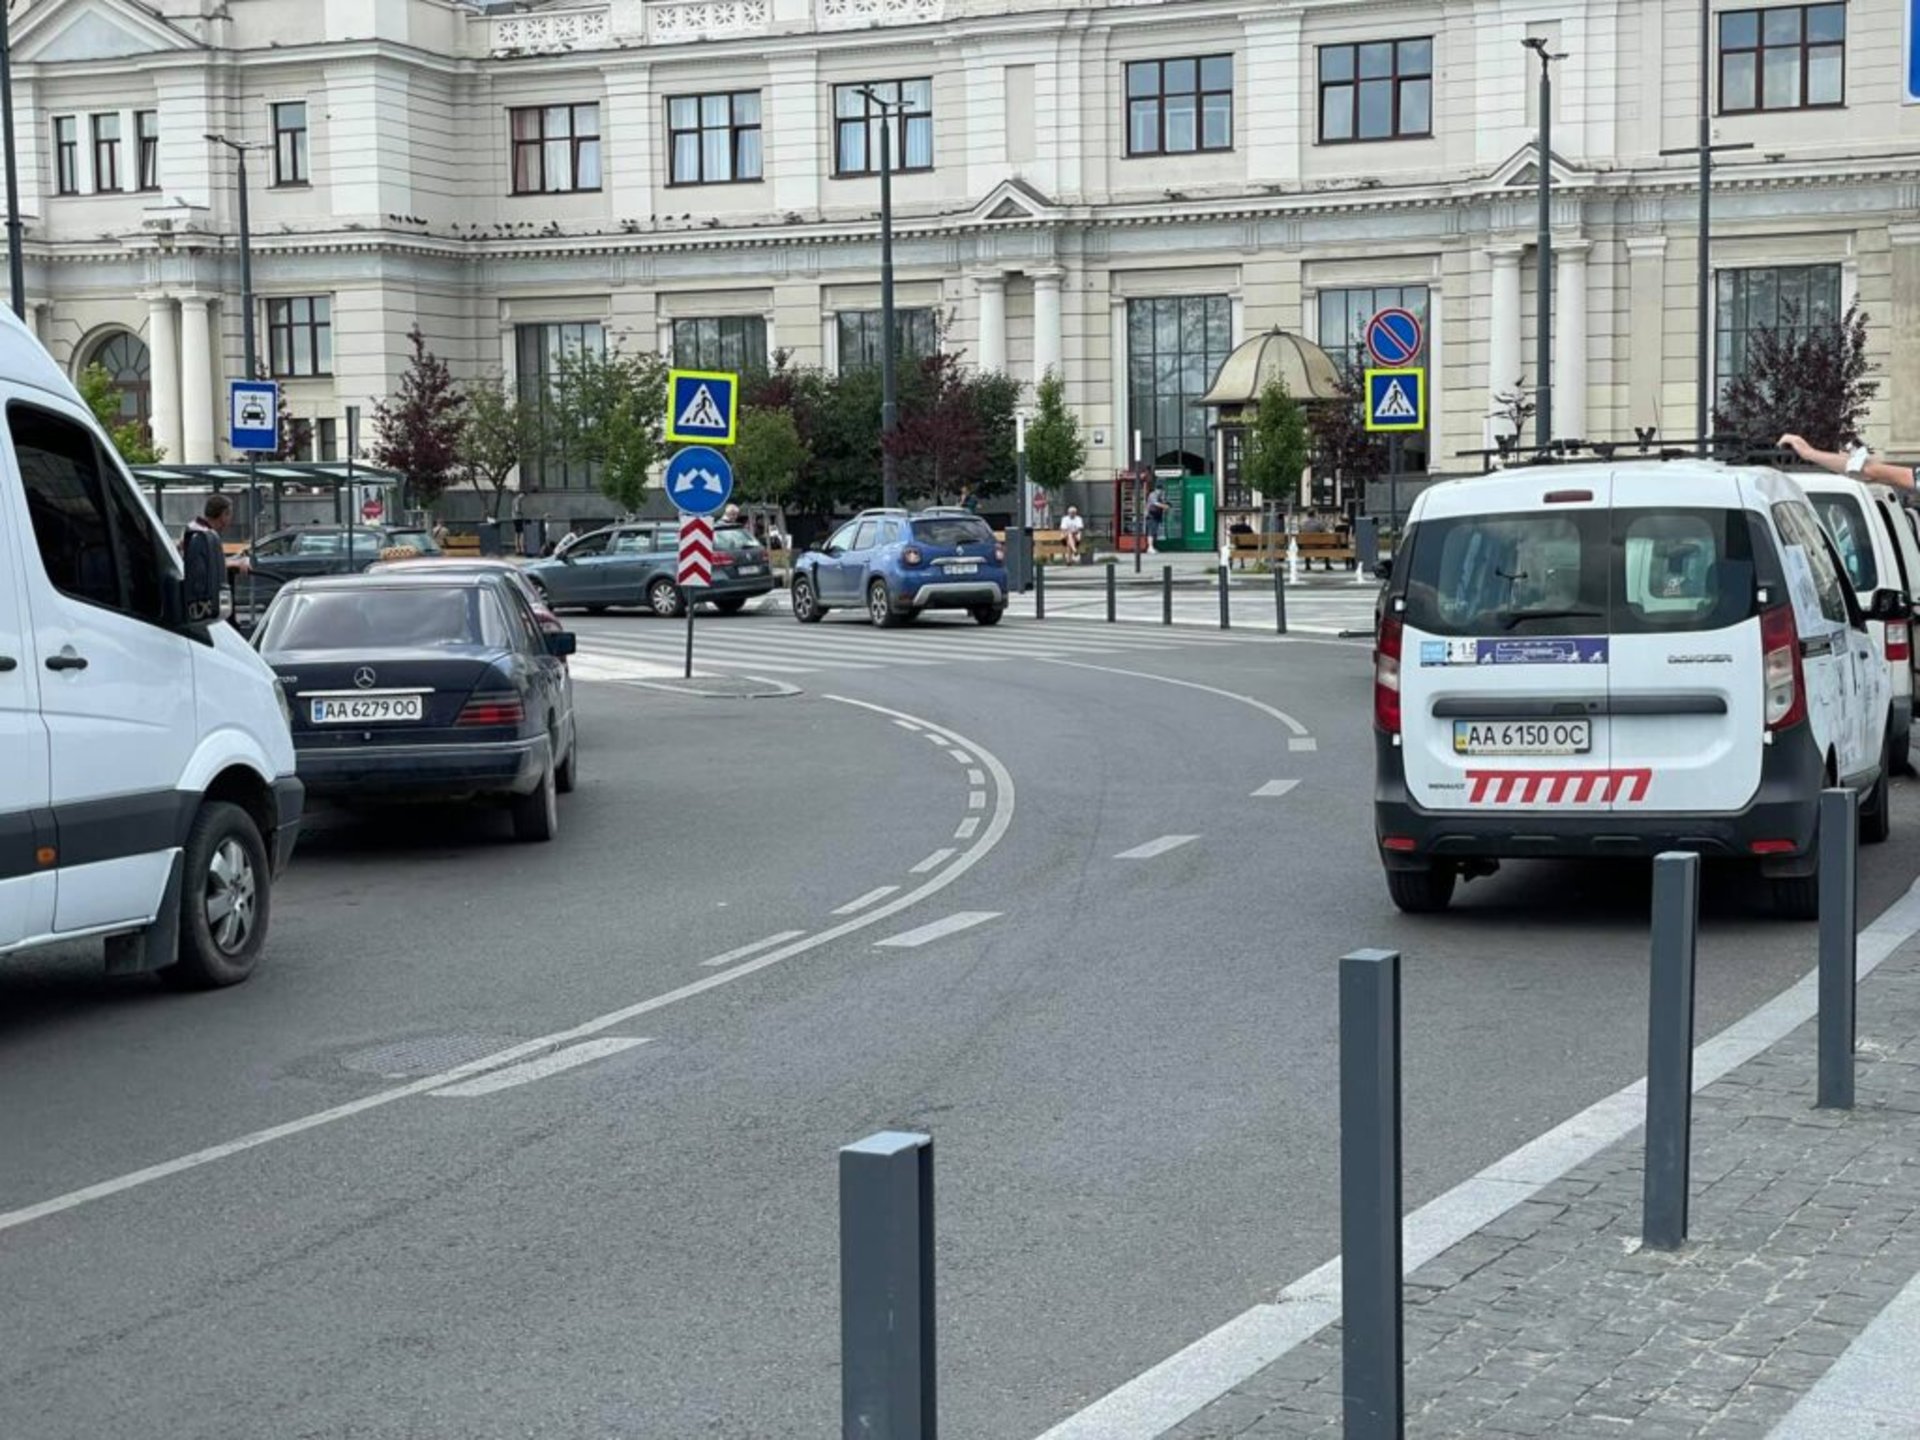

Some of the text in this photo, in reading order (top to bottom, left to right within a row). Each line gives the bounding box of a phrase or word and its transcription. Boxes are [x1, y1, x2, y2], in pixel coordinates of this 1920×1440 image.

[325, 703, 348, 718] AA
[352, 701, 390, 718] 6279
[1468, 725, 1584, 746] AA 6150 OC
